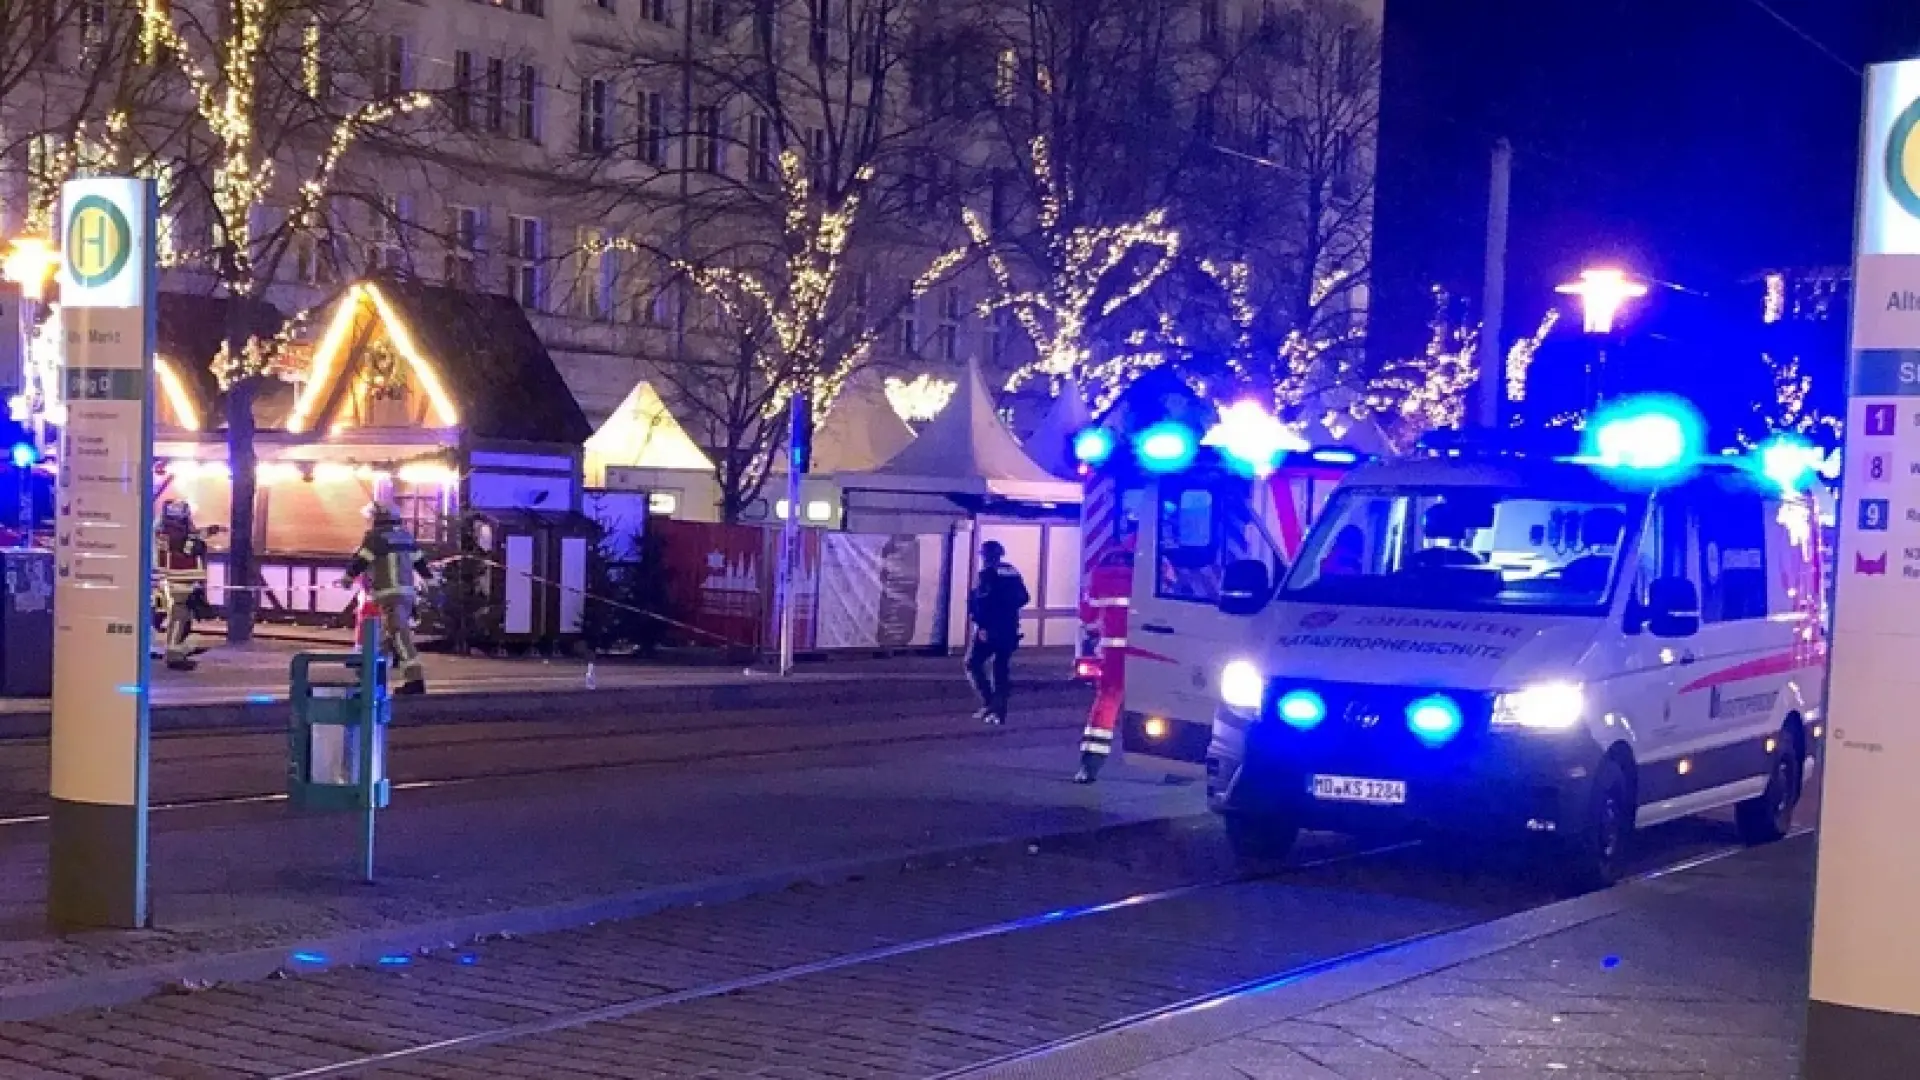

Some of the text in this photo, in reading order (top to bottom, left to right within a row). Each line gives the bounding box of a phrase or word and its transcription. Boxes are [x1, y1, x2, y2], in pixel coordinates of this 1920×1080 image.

[79, 215, 106, 268] H
[1874, 407, 1887, 432] 1
[1870, 455, 1884, 481] 8
[1866, 502, 1881, 526] 9
